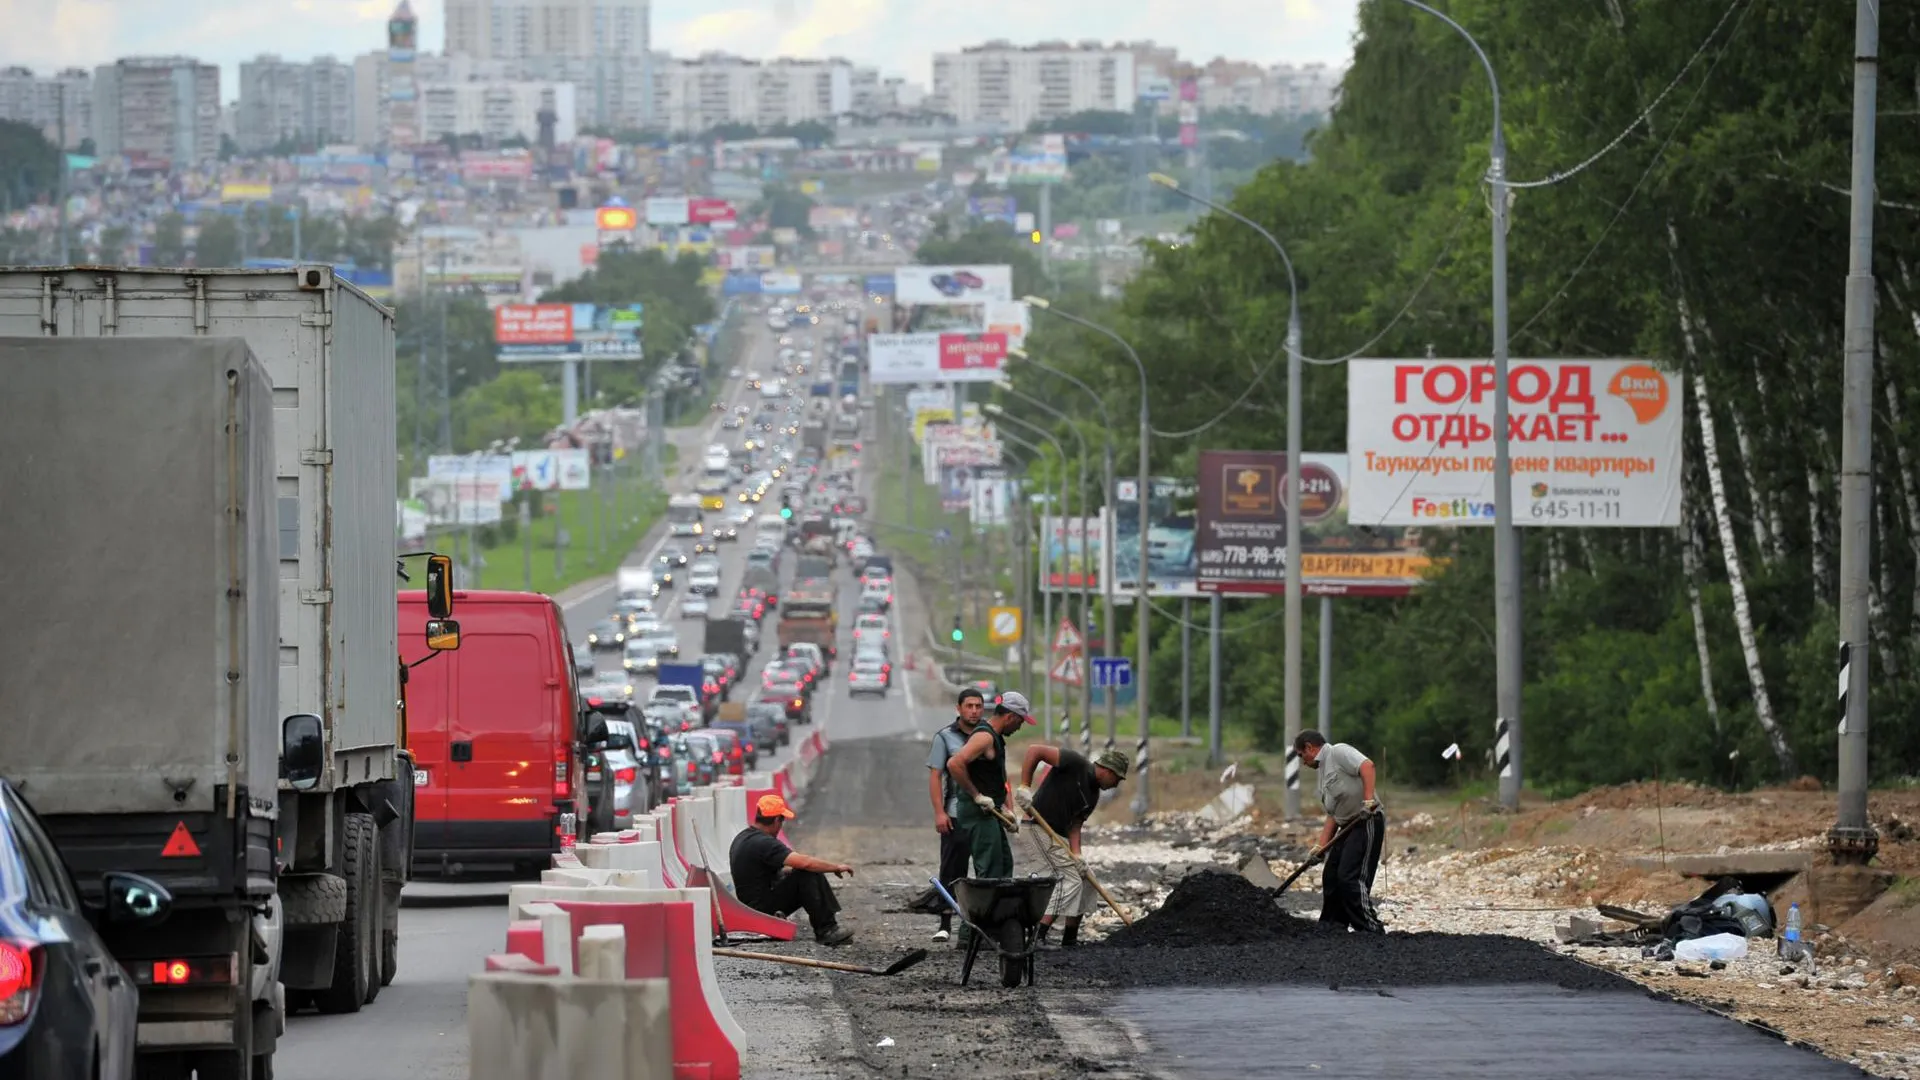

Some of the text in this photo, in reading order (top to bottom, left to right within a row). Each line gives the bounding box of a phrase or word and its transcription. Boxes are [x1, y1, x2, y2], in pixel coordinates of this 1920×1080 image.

[1394, 365, 1595, 413] ГОРОД
[1365, 451, 1467, 476] Таунхаусы
[1553, 456, 1655, 478] квартиры
[1412, 497, 1496, 518] Festiva
[1531, 501, 1620, 519] 645-11-11
